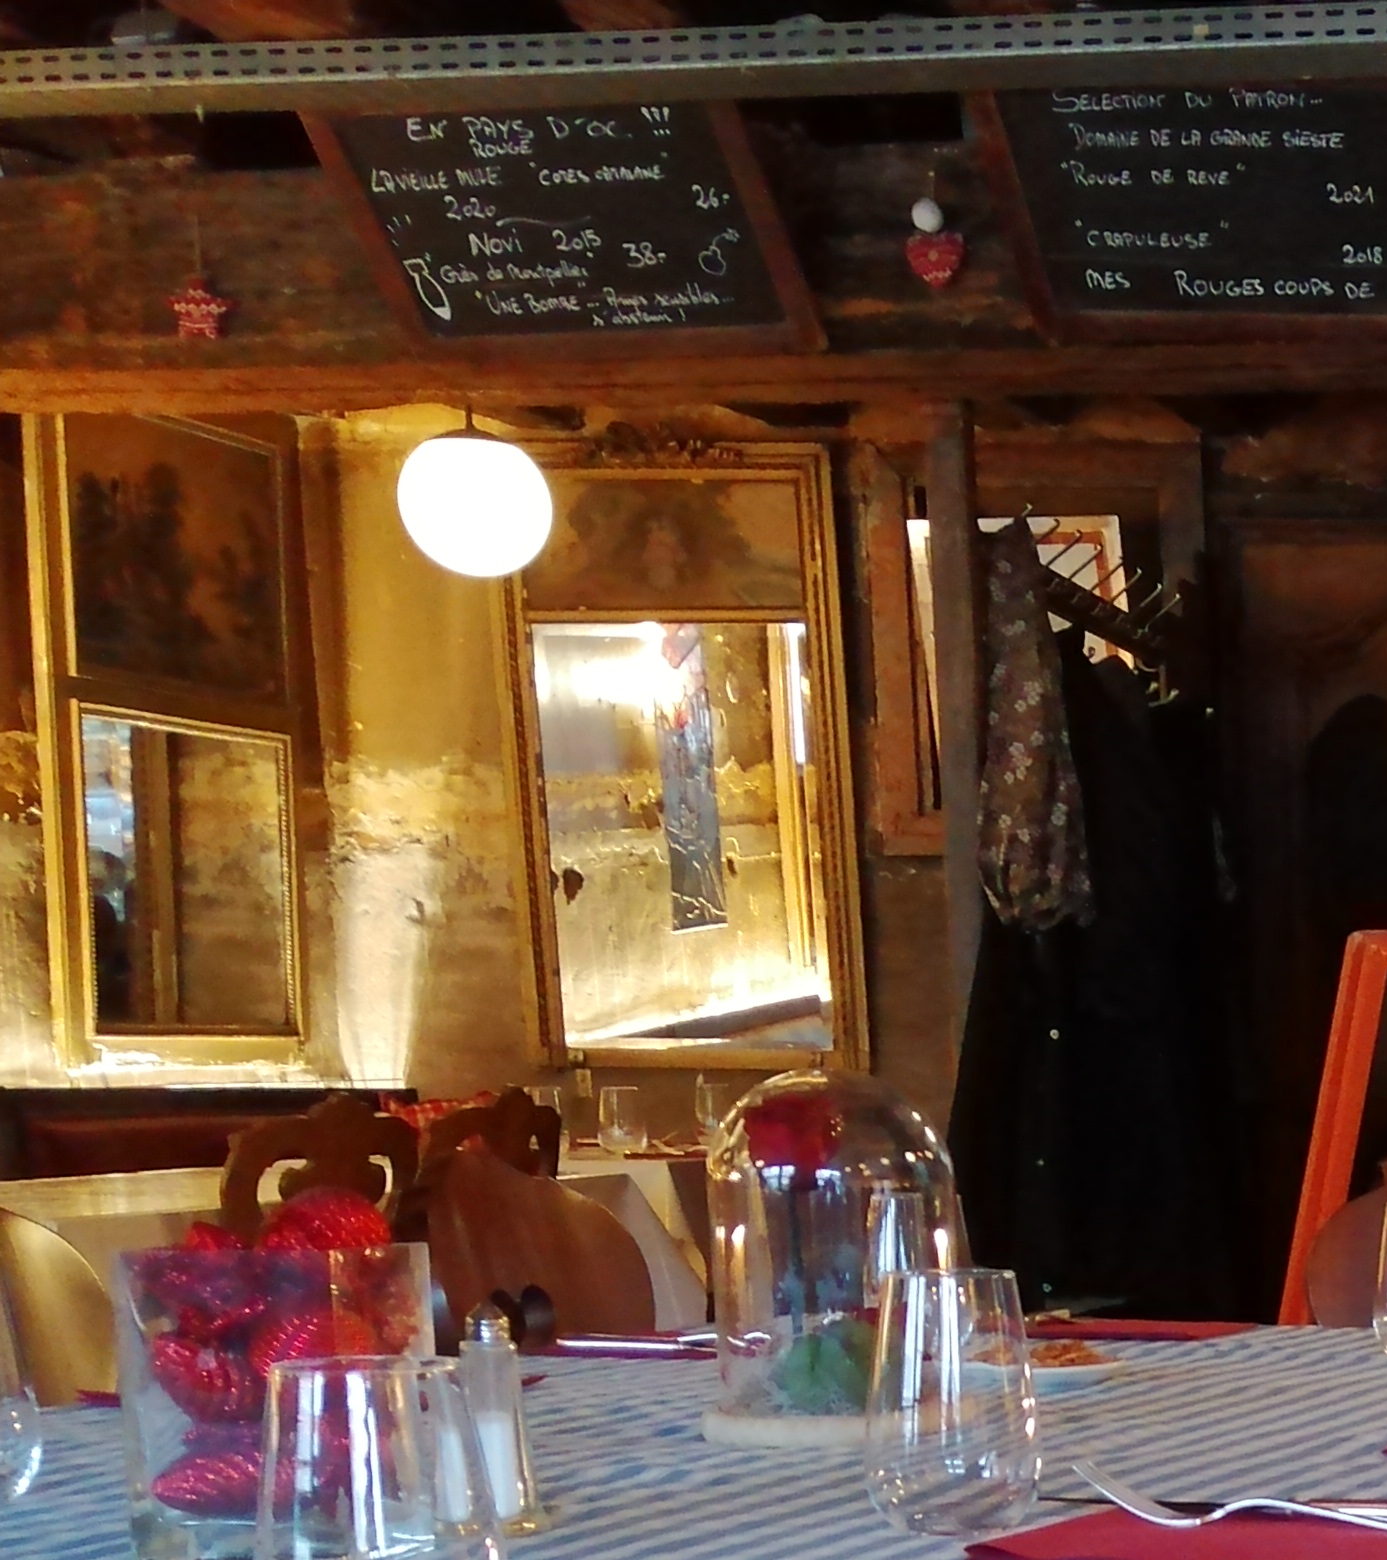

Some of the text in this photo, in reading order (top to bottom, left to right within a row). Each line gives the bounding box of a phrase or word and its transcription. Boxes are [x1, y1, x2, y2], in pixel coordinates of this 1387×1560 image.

[1052, 91, 1166, 112] SELECTION
[1184, 91, 1213, 108] DU
[462, 116, 534, 140] PAYS
[1068, 123, 1140, 150] DOMAINE
[1150, 128, 1172, 148] DE
[1181, 128, 1201, 147] LA
[1210, 128, 1272, 149] GRANDE
[469, 139, 532, 158] ROUGE
[1151, 168, 1174, 185] DE
[1326, 182, 1375, 205] 2021
[444, 195, 497, 222] 2020
[552, 229, 602, 251] 2015
[1341, 244, 1383, 265] 2018
[1085, 268, 1131, 291] MES
[1173, 269, 1265, 297] ROUGES
[1274, 276, 1335, 297] COUPS
[1344, 281, 1375, 300] DE
